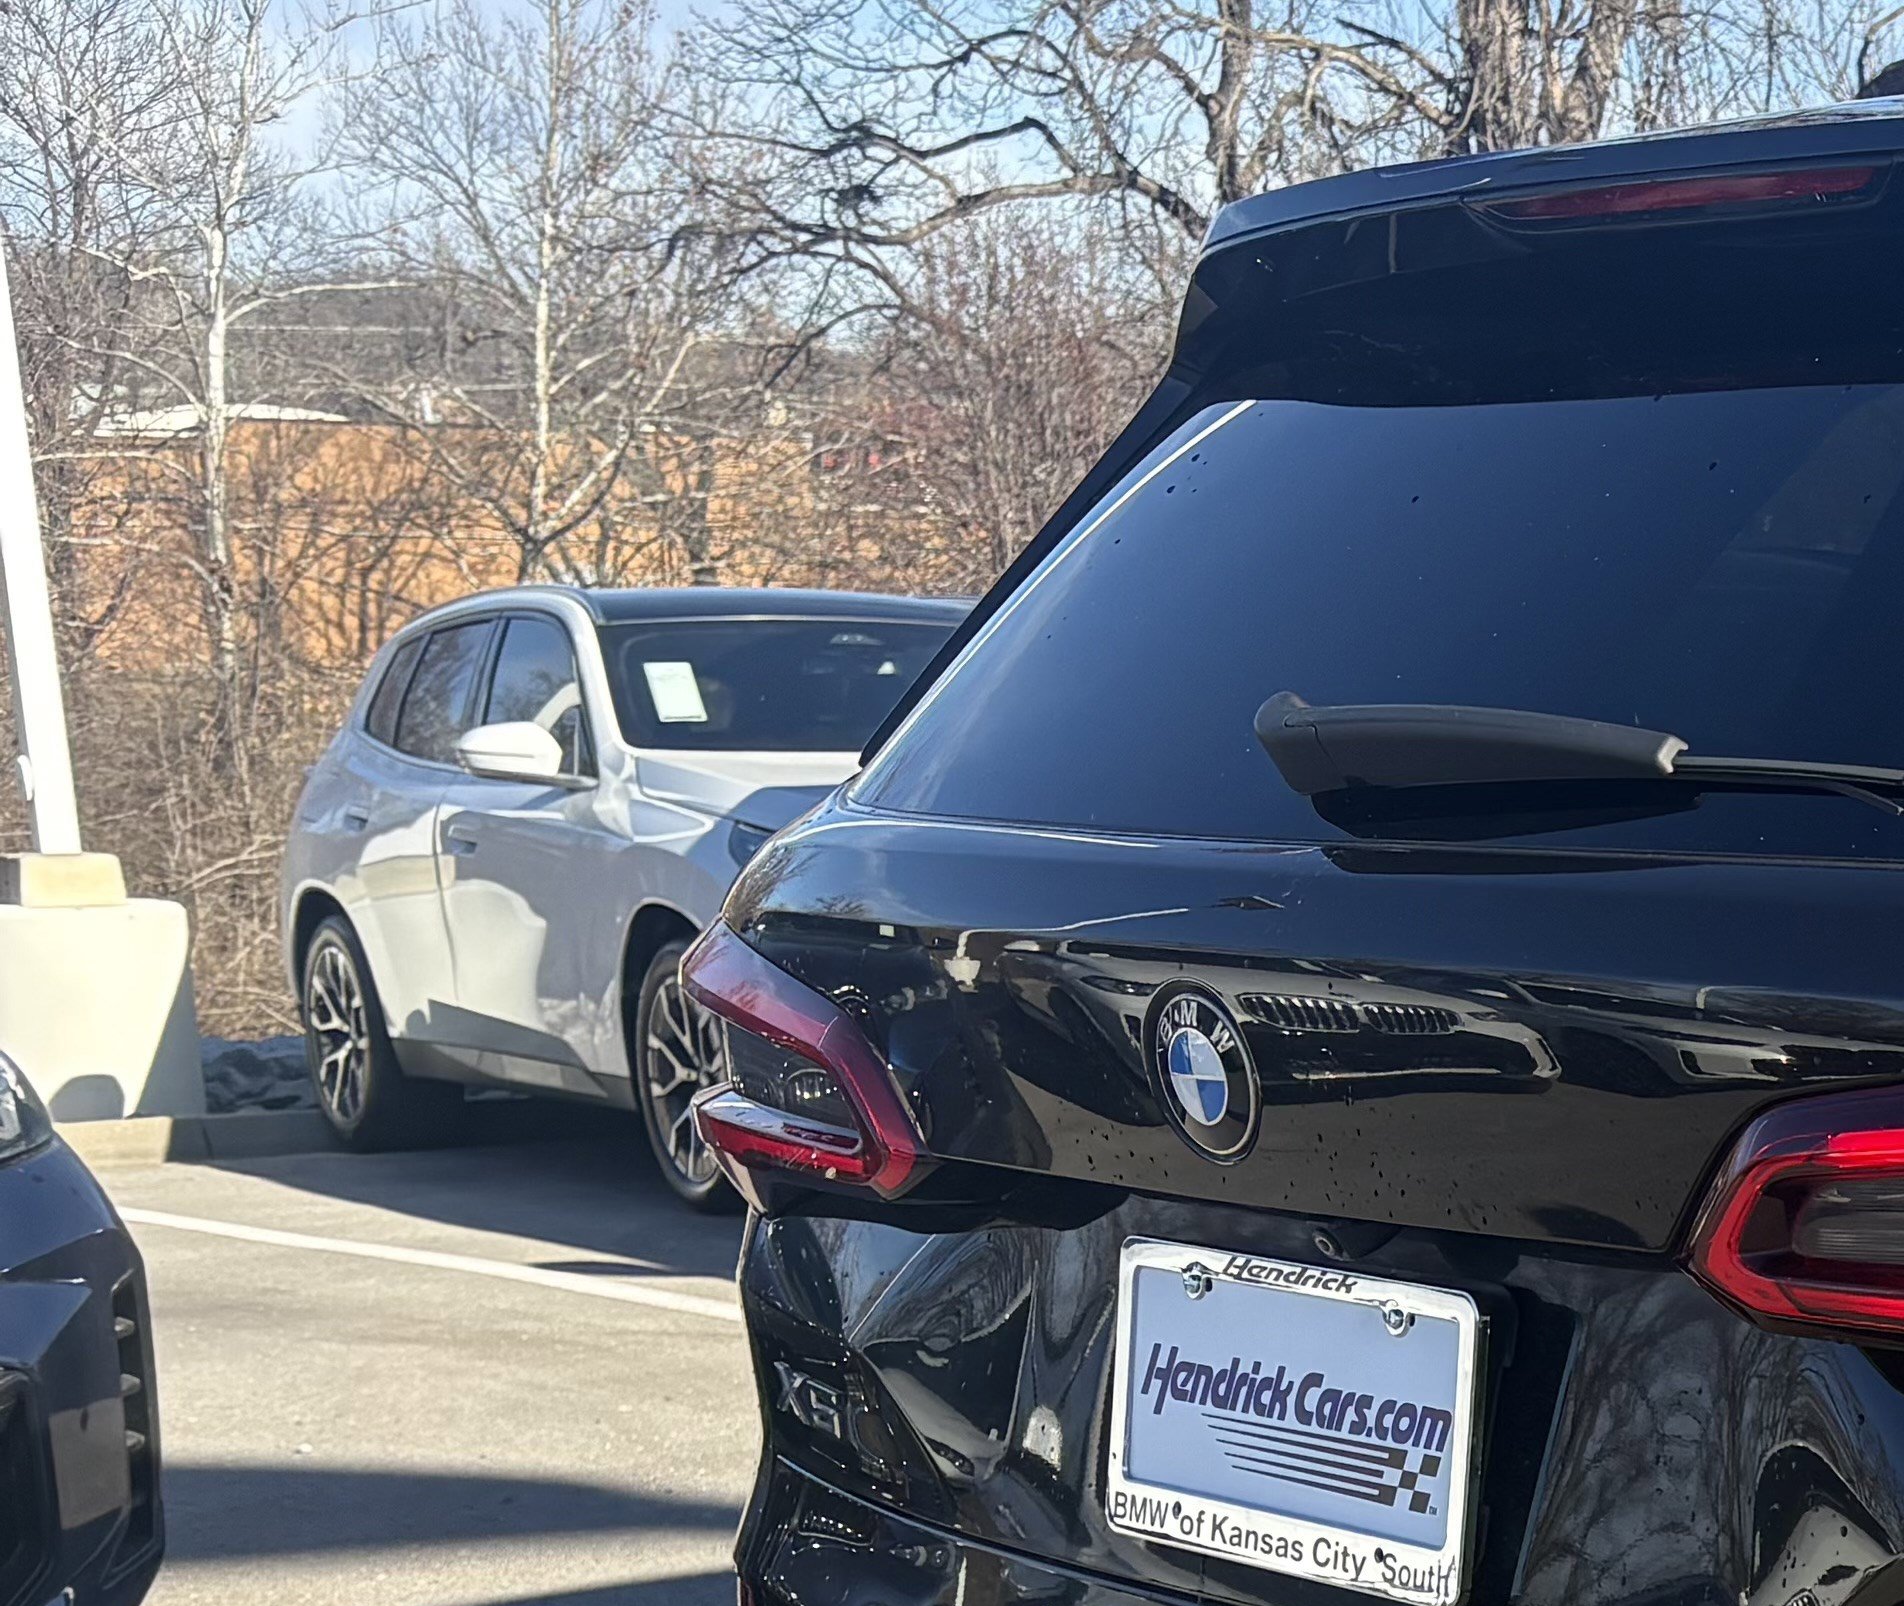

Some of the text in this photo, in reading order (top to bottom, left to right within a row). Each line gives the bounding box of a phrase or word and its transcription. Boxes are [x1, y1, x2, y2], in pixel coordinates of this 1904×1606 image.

[1160, 1000, 1236, 1054] BMW
[1222, 1255, 1358, 1294] Hendrick
[1141, 1342, 1452, 1452] HendrickCars.com
[1113, 1494, 1453, 1597] BMW of Kansas City South
